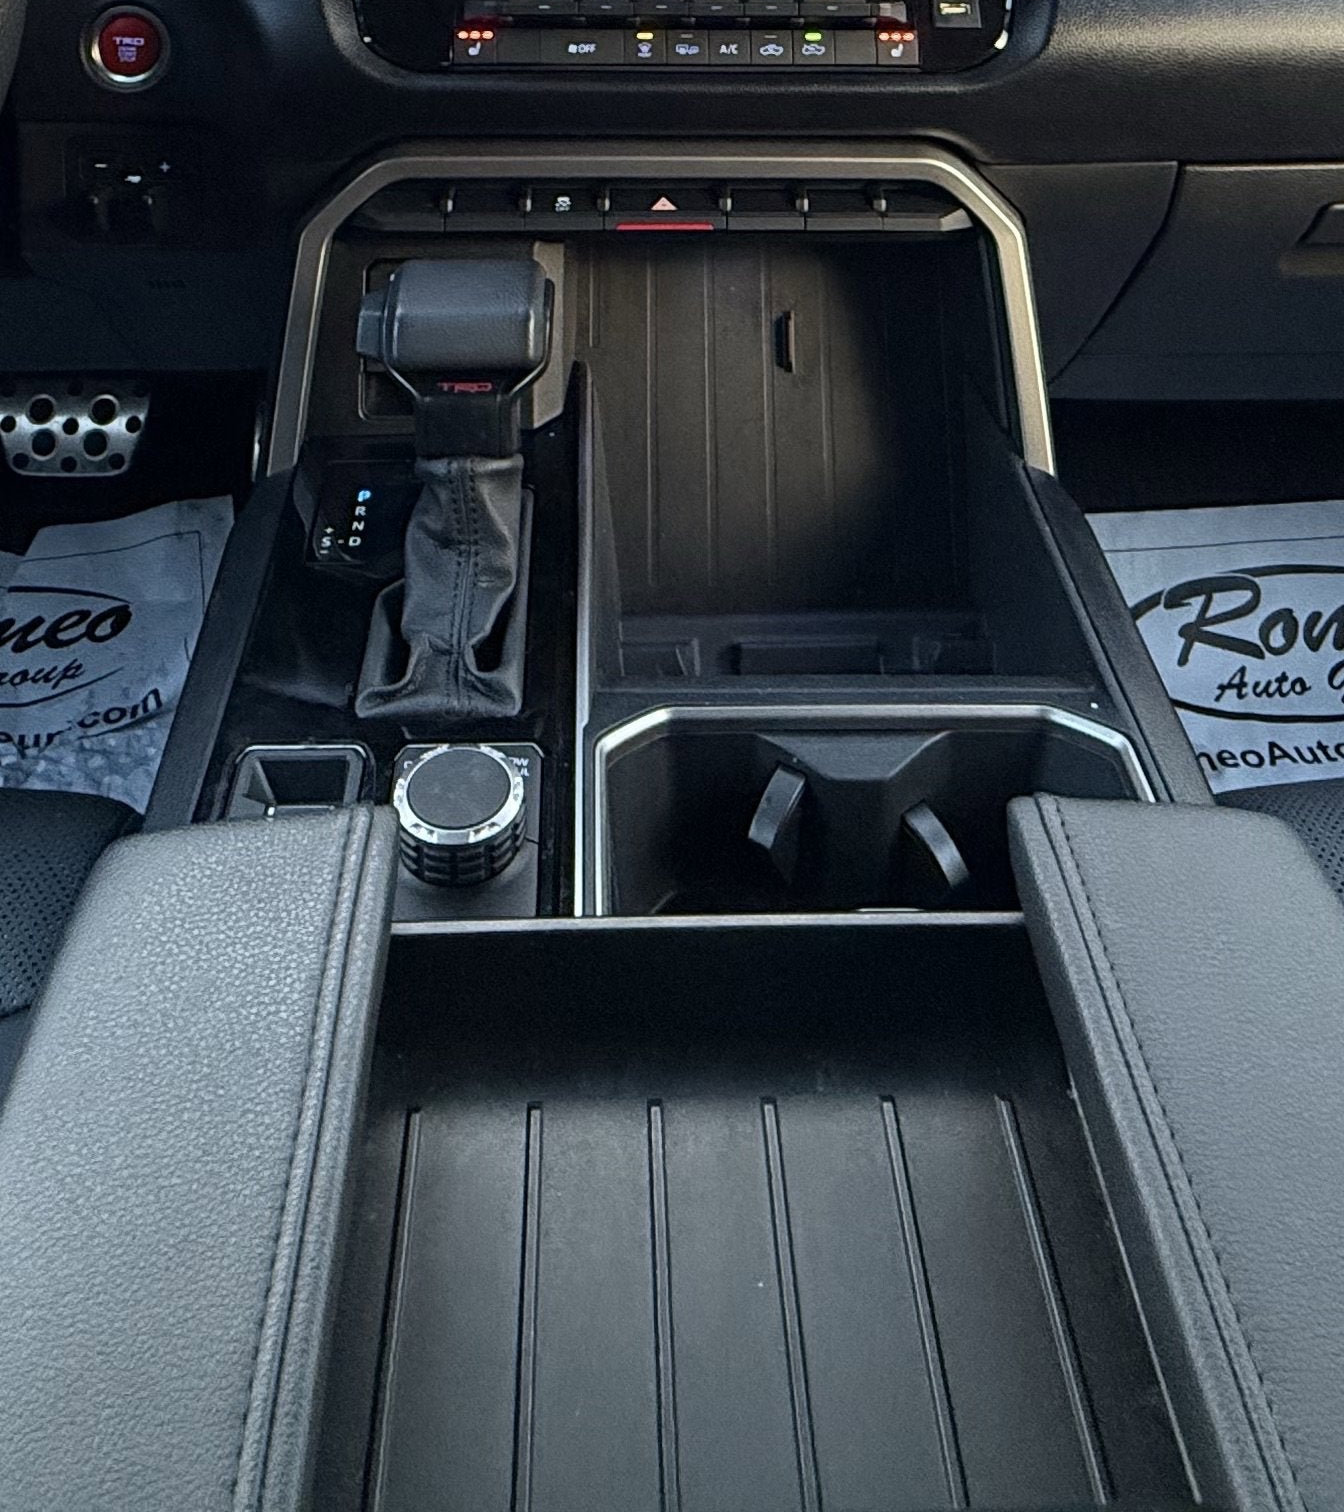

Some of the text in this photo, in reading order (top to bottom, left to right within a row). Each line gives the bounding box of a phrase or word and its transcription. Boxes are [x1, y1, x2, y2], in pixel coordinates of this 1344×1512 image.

[112, 36, 145, 46] TRD
[578, 43, 597, 54] OFF
[719, 43, 739, 55] A/C
[438, 382, 492, 393] TRD
[358, 490, 372, 502] P
[355, 506, 367, 517] R
[352, 521, 365, 531] N
[349, 536, 362, 547] D
[1214, 664, 1312, 703] Auto
